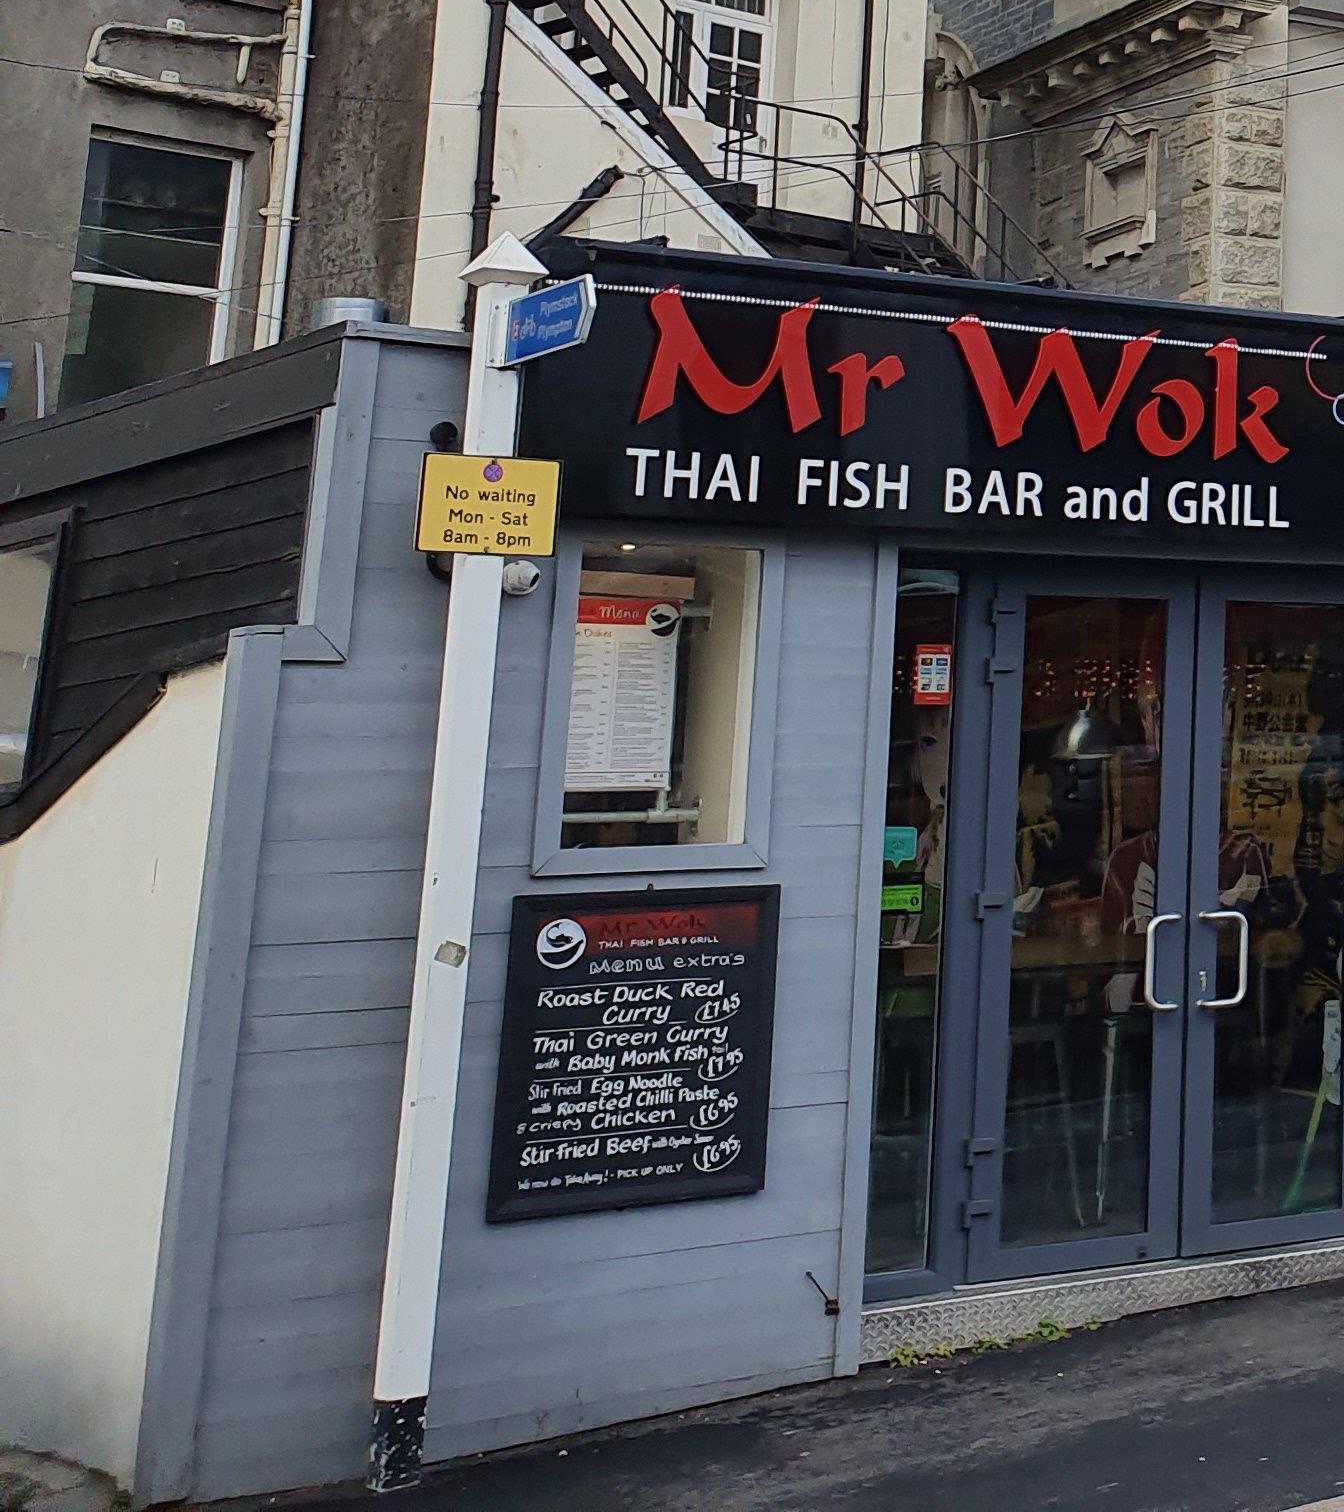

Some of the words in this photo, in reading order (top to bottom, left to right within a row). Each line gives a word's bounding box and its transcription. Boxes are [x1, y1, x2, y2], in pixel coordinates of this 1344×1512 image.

[637, 283, 905, 437] Mr
[945, 313, 1290, 464] Wok
[445, 485, 469, 500] No
[478, 488, 536, 506] waiting
[626, 446, 760, 503] THAI
[797, 458, 910, 510] FISH
[945, 466, 1043, 517] BAR
[1063, 476, 1149, 522] and
[1167, 480, 1290, 529] GRILL
[448, 509, 483, 524] Mon
[501, 512, 529, 527] Sat
[443, 529, 478, 544] 8am
[496, 531, 531, 548] 8pm
[598, 939, 624, 950] THAI
[629, 937, 654, 948] FISH
[657, 936, 680, 947] BAR
[689, 935, 720, 945] GRILL
[536, 989, 609, 1010] Roast
[612, 984, 673, 1004] Duck
[680, 978, 724, 998] Red
[602, 1004, 671, 1026] Curry
[533, 1031, 575, 1054] Thai
[586, 1030, 657, 1050] Green
[666, 1025, 729, 1044] Curry
[567, 1054, 616, 1074] Baby
[620, 1048, 671, 1067] Monk
[673, 1045, 708, 1062] Fish
[589, 1076, 625, 1097] Egg
[628, 1072, 684, 1091] Noodle
[556, 1092, 632, 1117] Roasted
[635, 1089, 674, 1110] Chilli
[678, 1085, 720, 1103] Paste
[590, 1108, 676, 1130] Chicken
[519, 1145, 552, 1167] Stir
[606, 1135, 652, 1156] Beef
[616, 1168, 638, 1180] PICK
[640, 1166, 654, 1176] UP
[656, 1163, 684, 1175] ONLY
